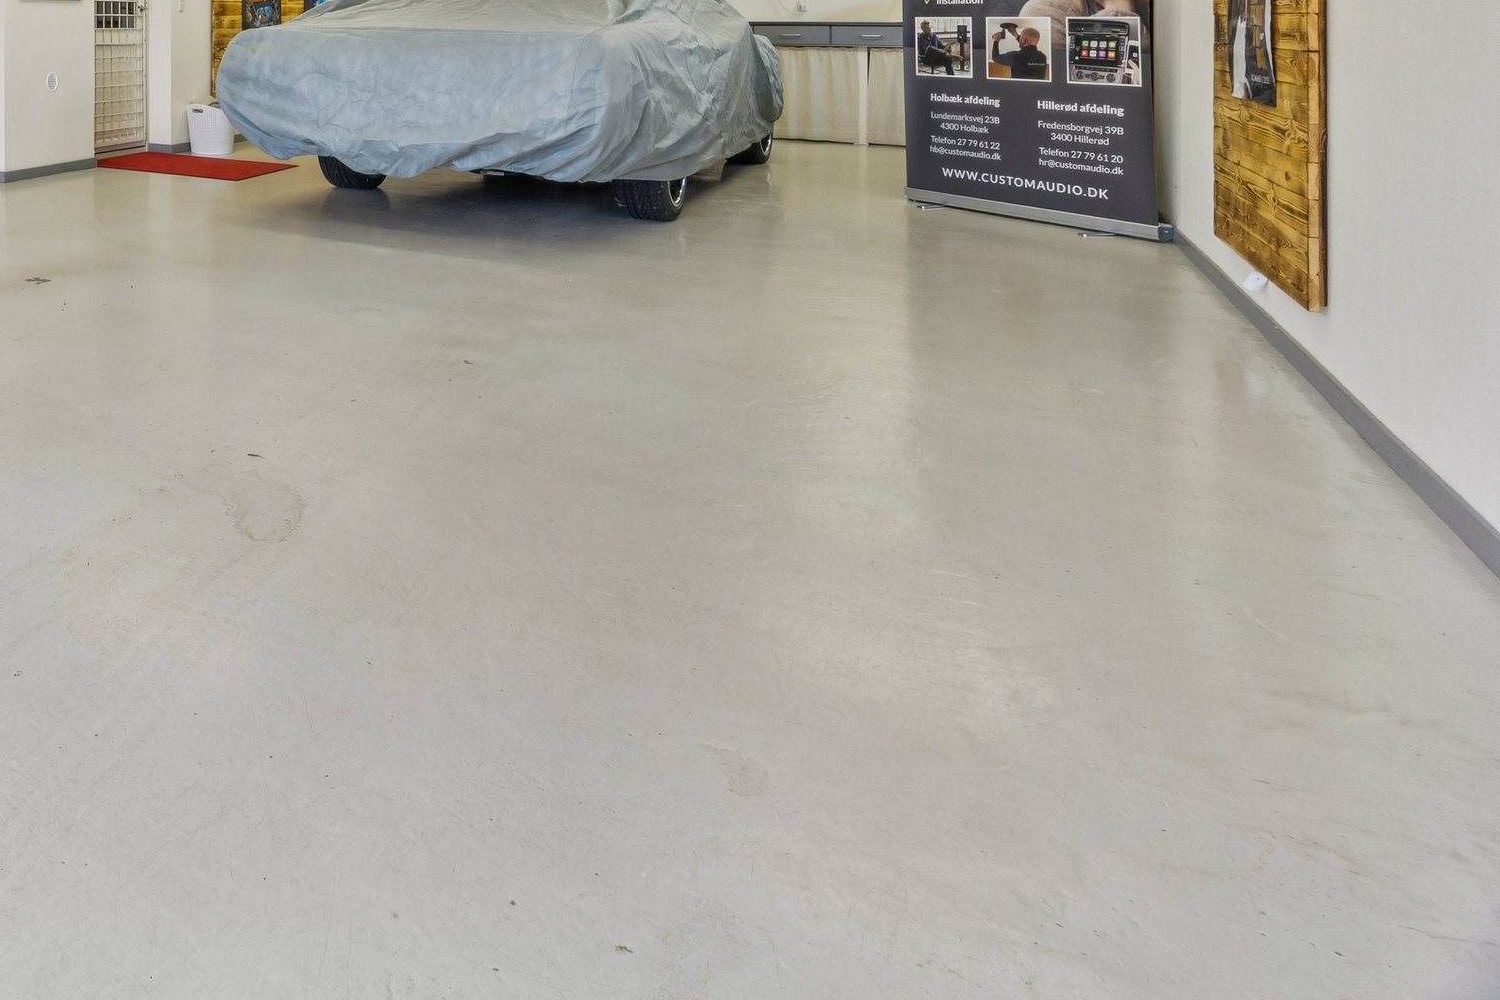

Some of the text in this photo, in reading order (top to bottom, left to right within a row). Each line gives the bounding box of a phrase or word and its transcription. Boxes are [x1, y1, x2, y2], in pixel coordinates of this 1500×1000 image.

[930, 93, 1000, 107] Holbæk afdeling
[1037, 100, 1124, 116] Hillerød afdeling
[930, 112, 1000, 124] Lundemarksvej 23B
[940, 122, 988, 133] 4300 Holbæk
[1038, 121, 1124, 135] Fredensborgvej 39B
[930, 135, 956, 145] Telefon
[1050, 133, 1109, 145] 3400 Hillerød
[930, 145, 1001, 160] hb@customaudio.dk
[1039, 147, 1124, 164] Telefon 27 79 61 20
[1039, 158, 1124, 175] hr@customaudio.dk
[942, 167, 1108, 199] WWW.CUSTOMAUDIO.DK
